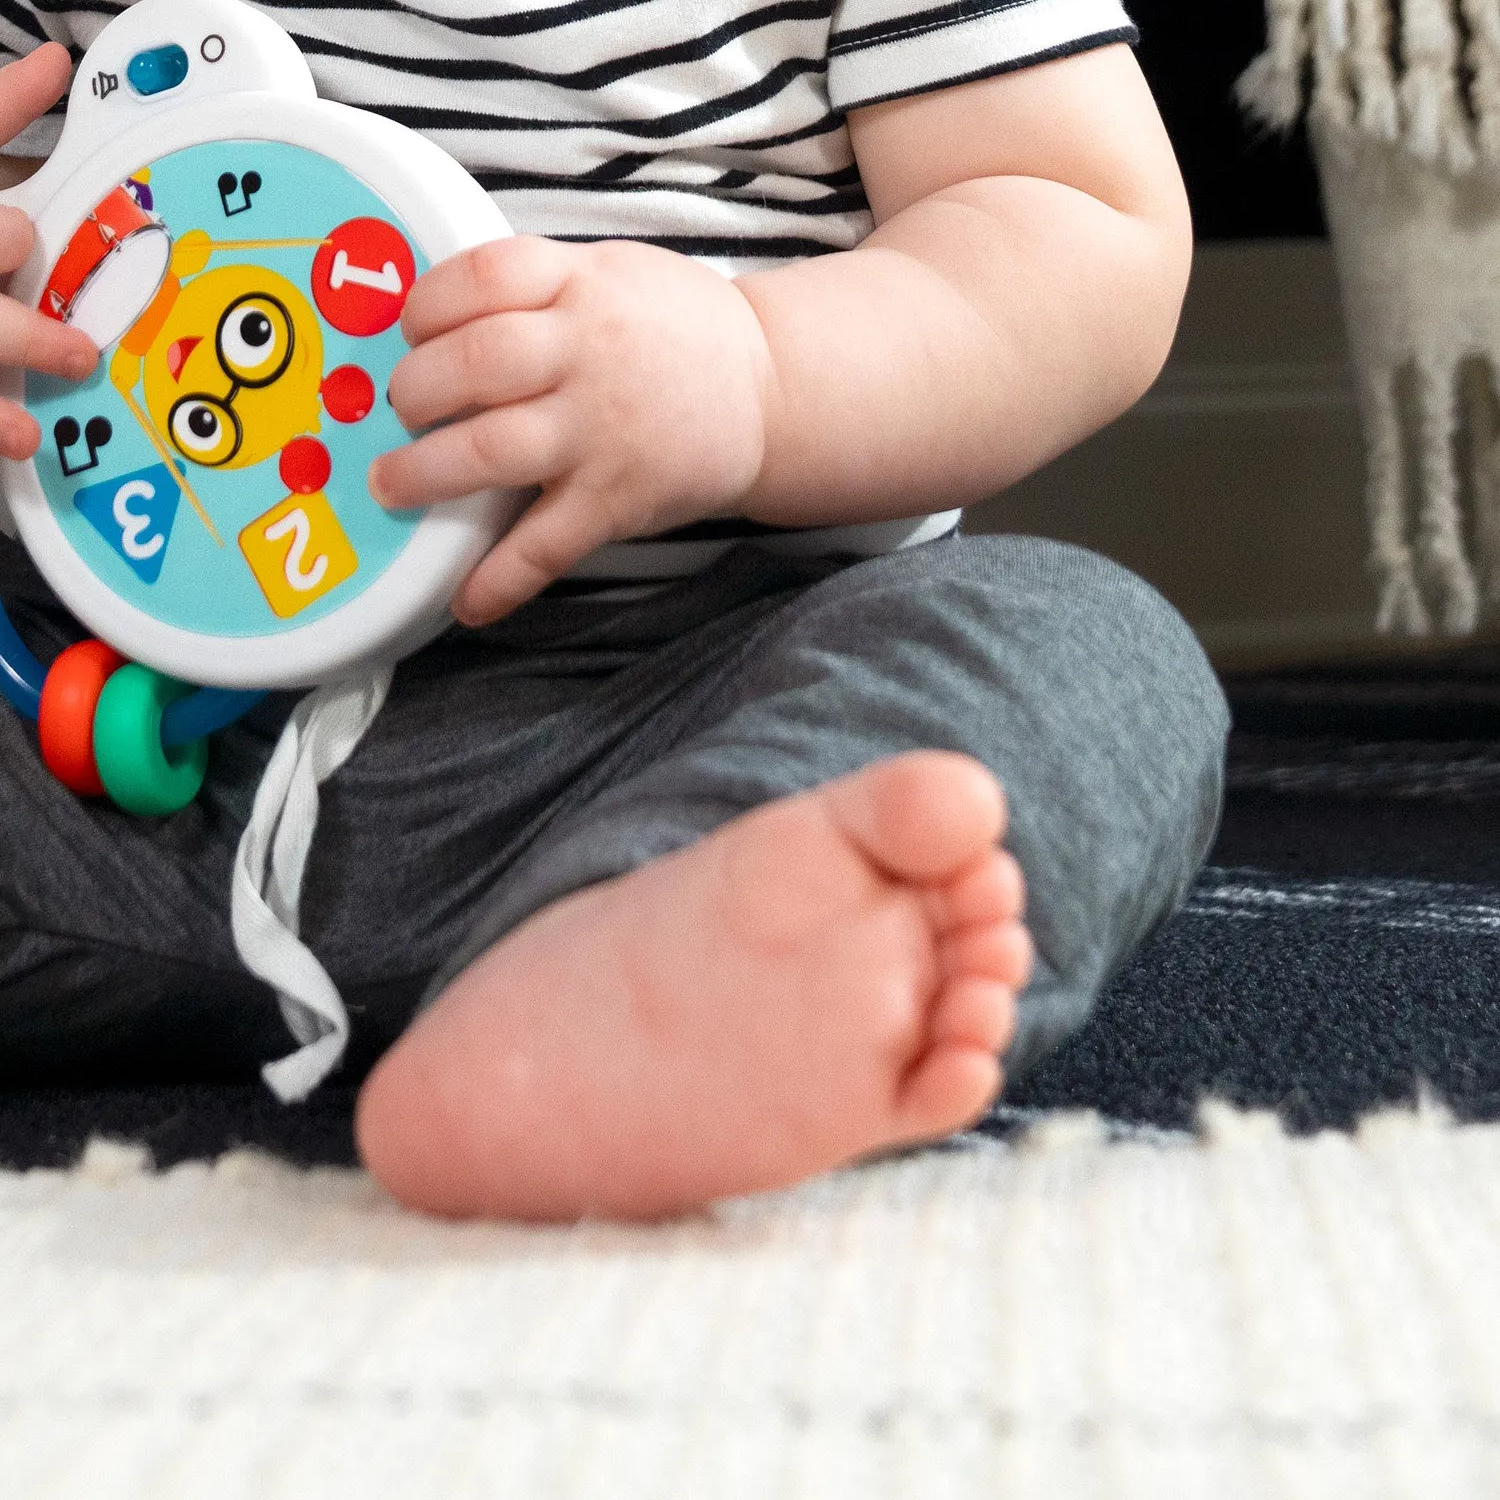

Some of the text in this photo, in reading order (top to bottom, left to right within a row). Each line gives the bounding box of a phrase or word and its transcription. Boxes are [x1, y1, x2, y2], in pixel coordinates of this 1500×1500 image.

[329, 248, 403, 297] 1
[112, 479, 165, 561] 3
[264, 507, 329, 592] 2
